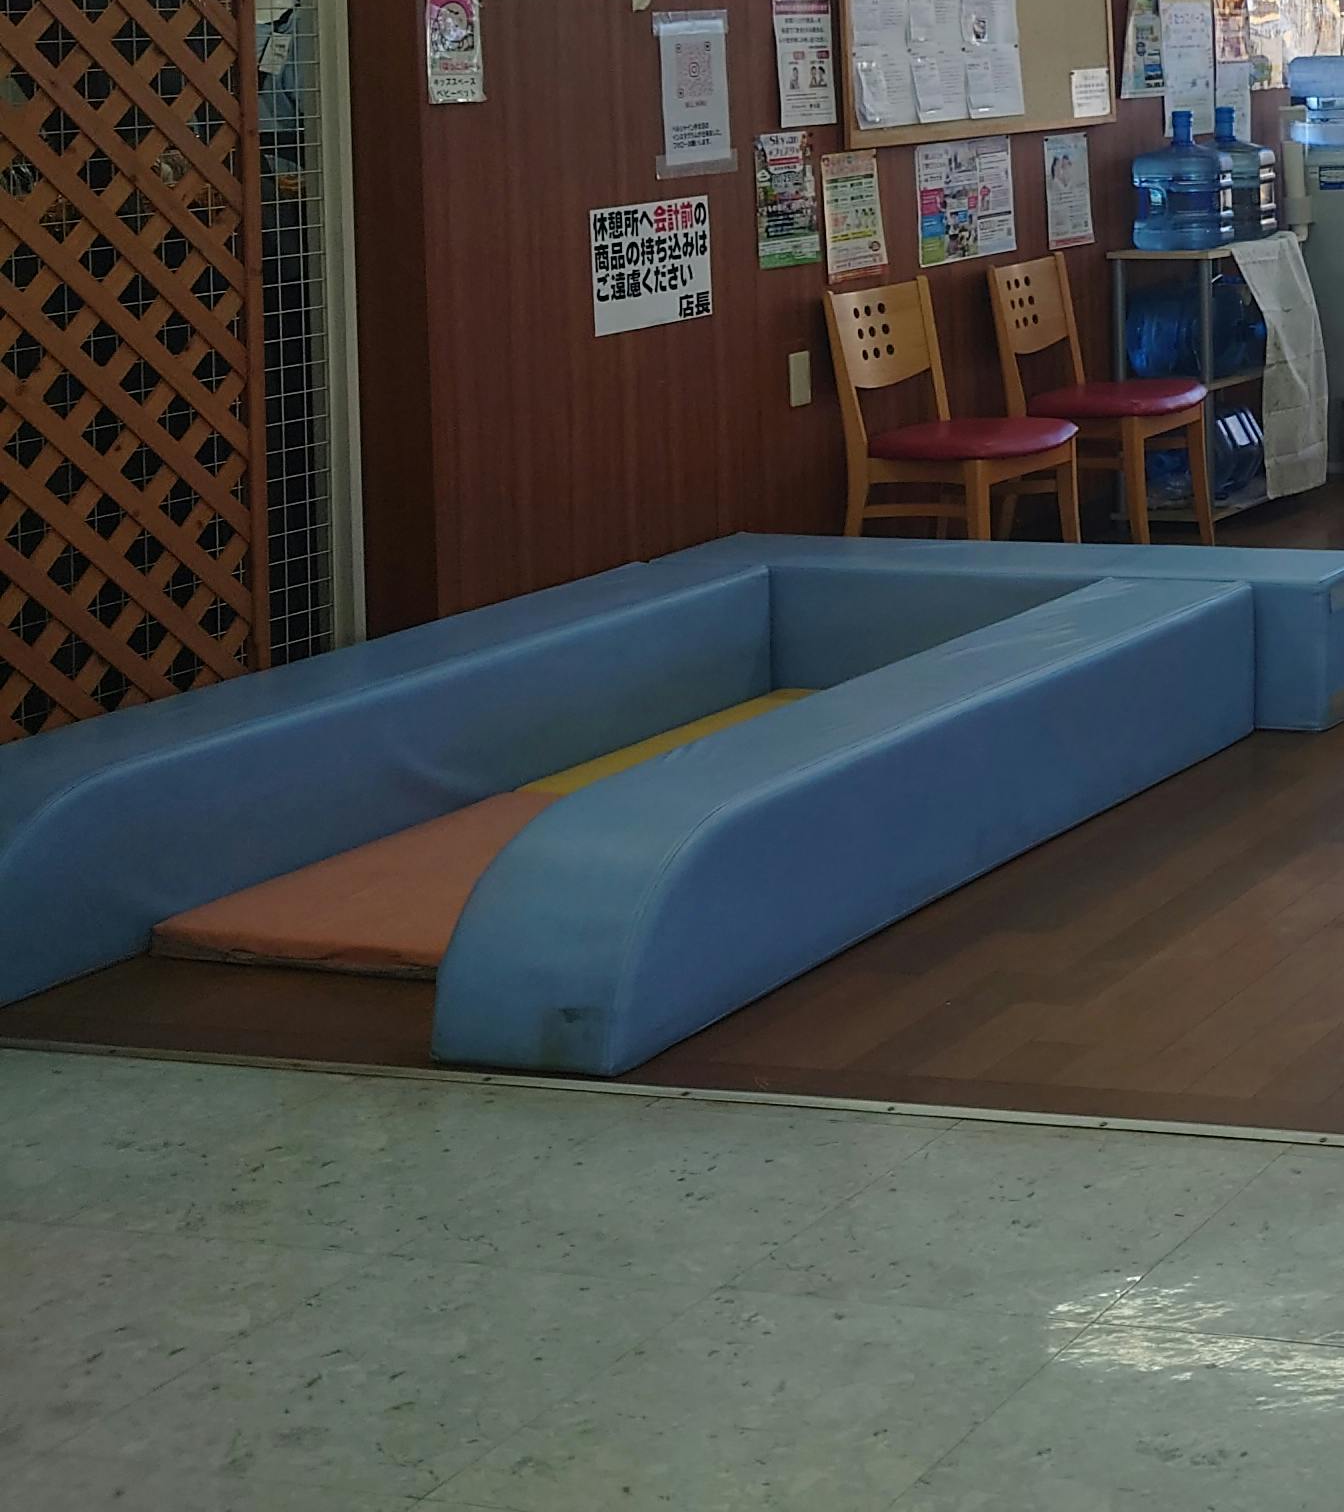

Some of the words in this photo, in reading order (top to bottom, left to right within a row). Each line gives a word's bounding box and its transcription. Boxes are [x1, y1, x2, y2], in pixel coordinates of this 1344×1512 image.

[593, 202, 707, 241] 休憩所へ会計前の
[594, 230, 707, 273] 商品の持ち込みは
[597, 263, 693, 302] ご遠慮ください
[679, 291, 710, 318] 店長
